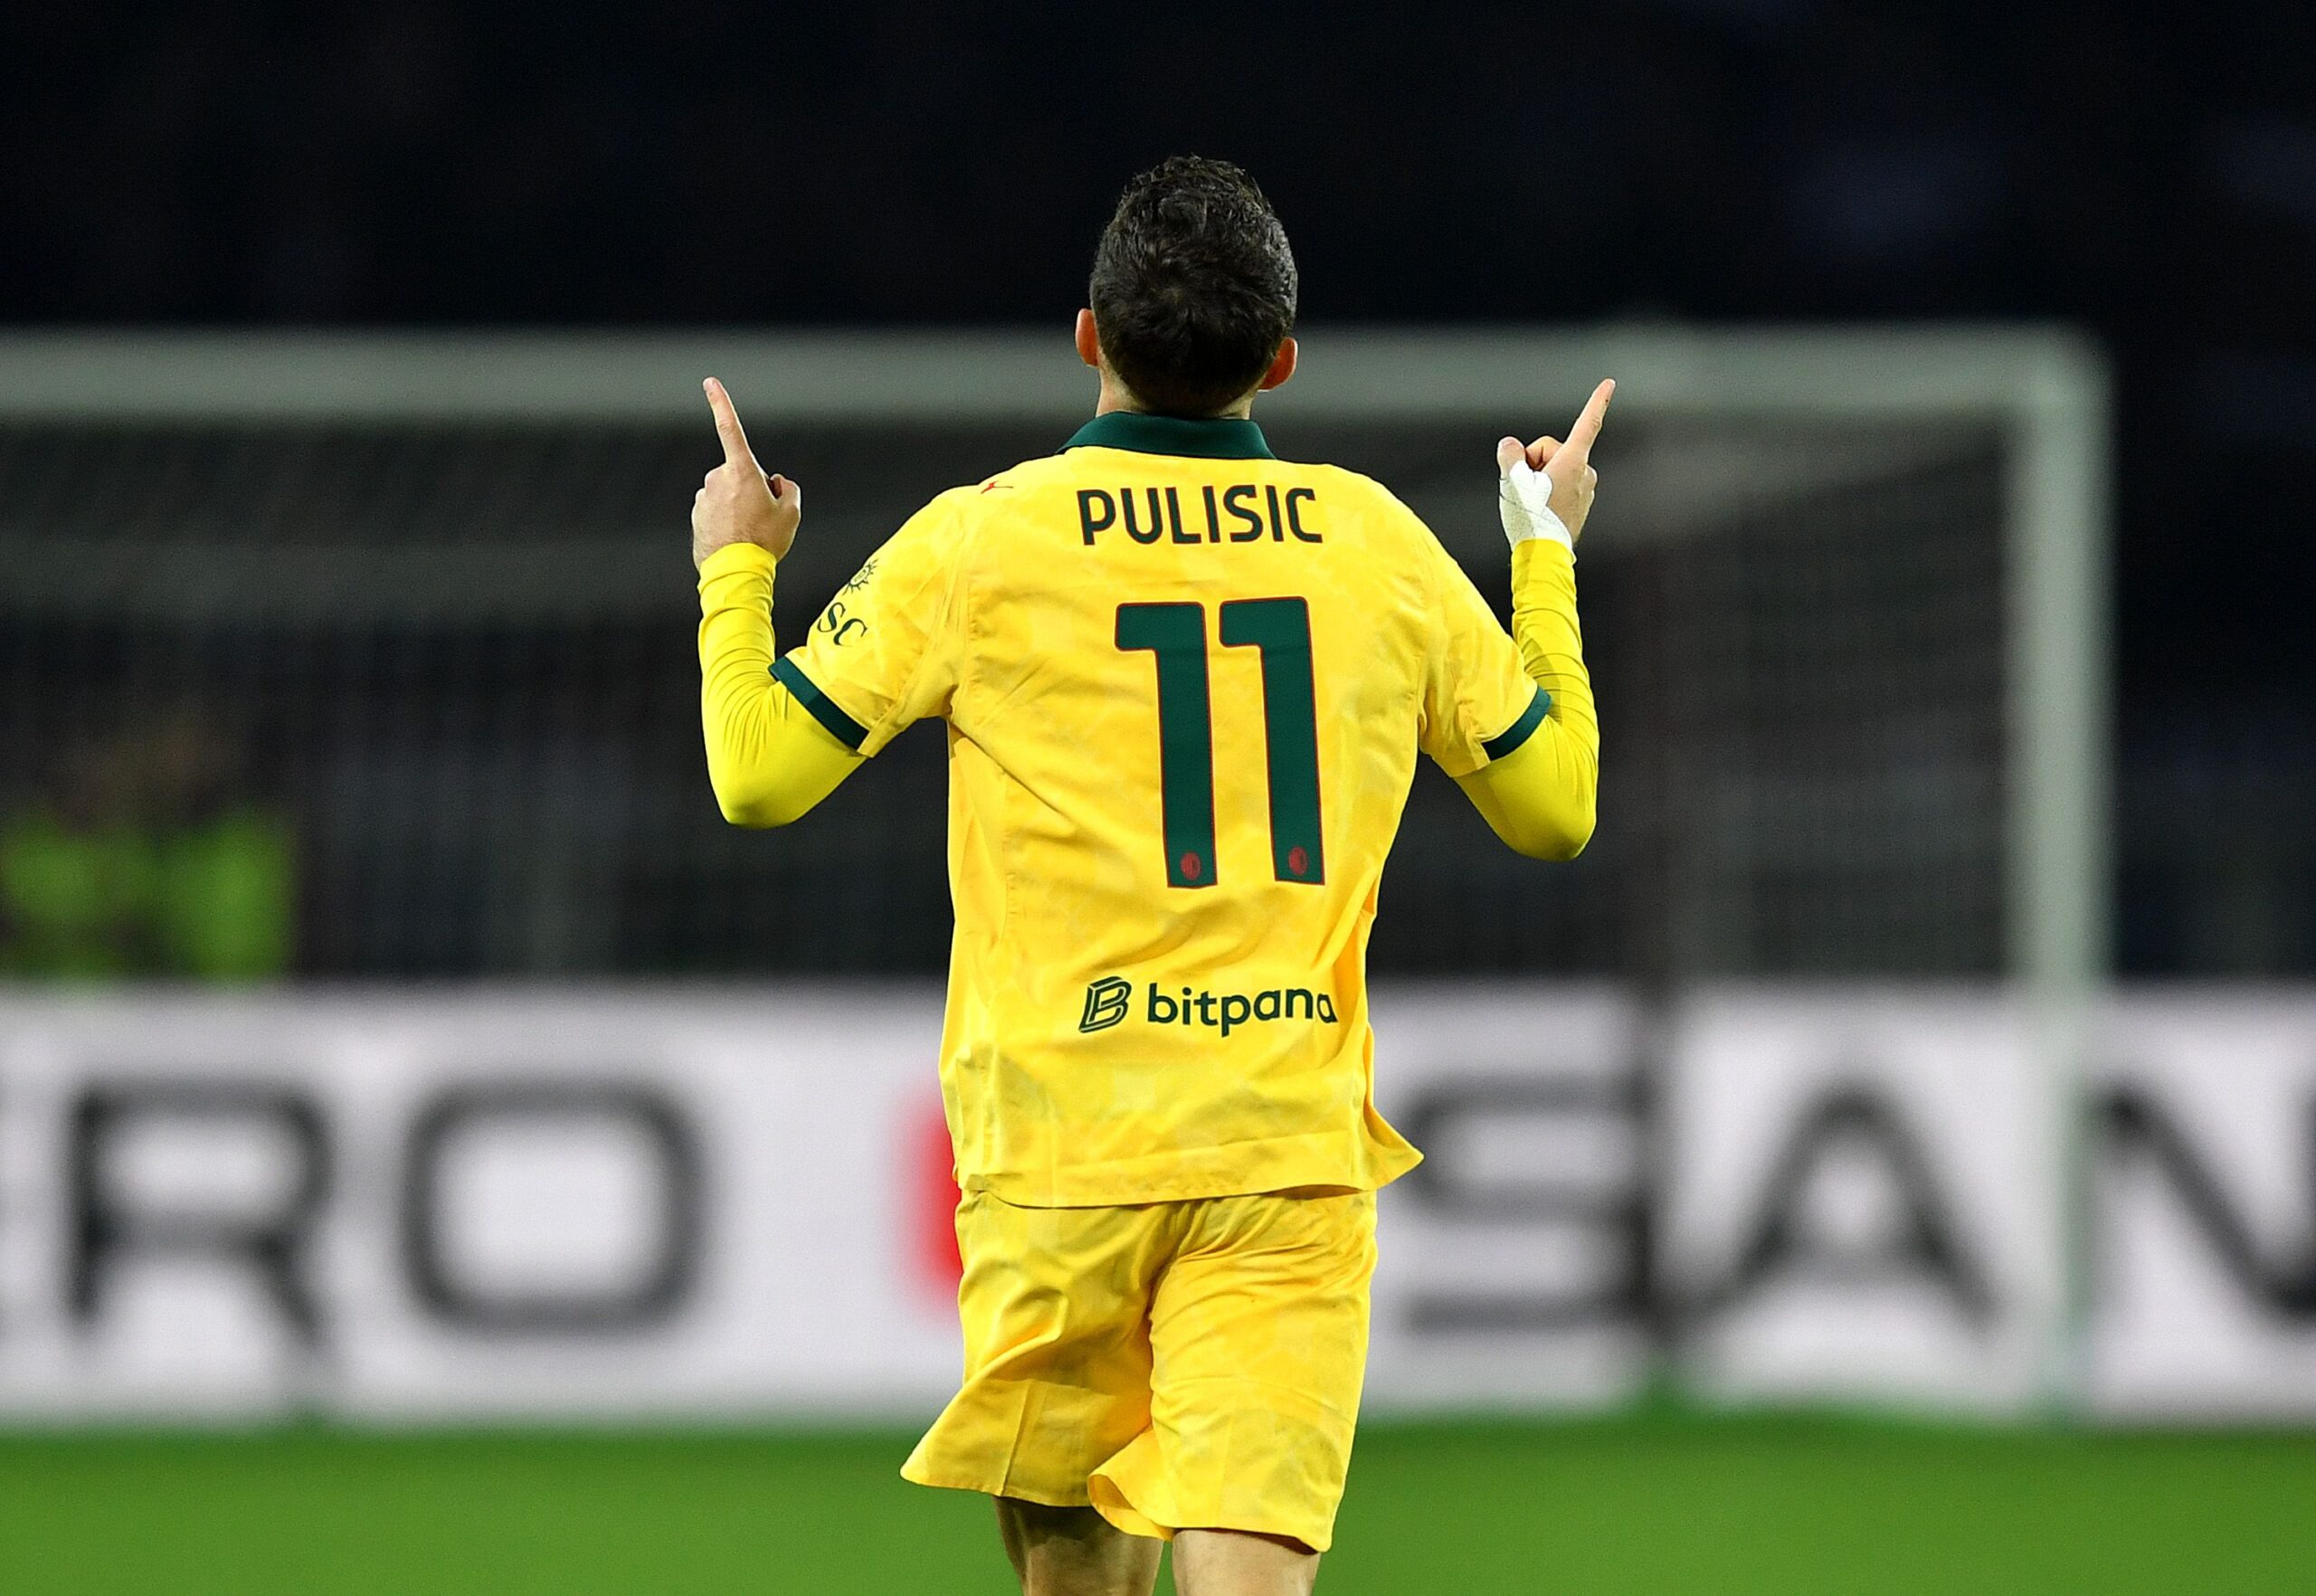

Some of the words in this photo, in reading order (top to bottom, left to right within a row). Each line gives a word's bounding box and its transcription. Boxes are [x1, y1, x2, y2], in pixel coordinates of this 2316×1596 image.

[1077, 484, 1323, 546] PULISIC
[1114, 595, 1325, 889] 11
[0, 1075, 710, 1344] RO
